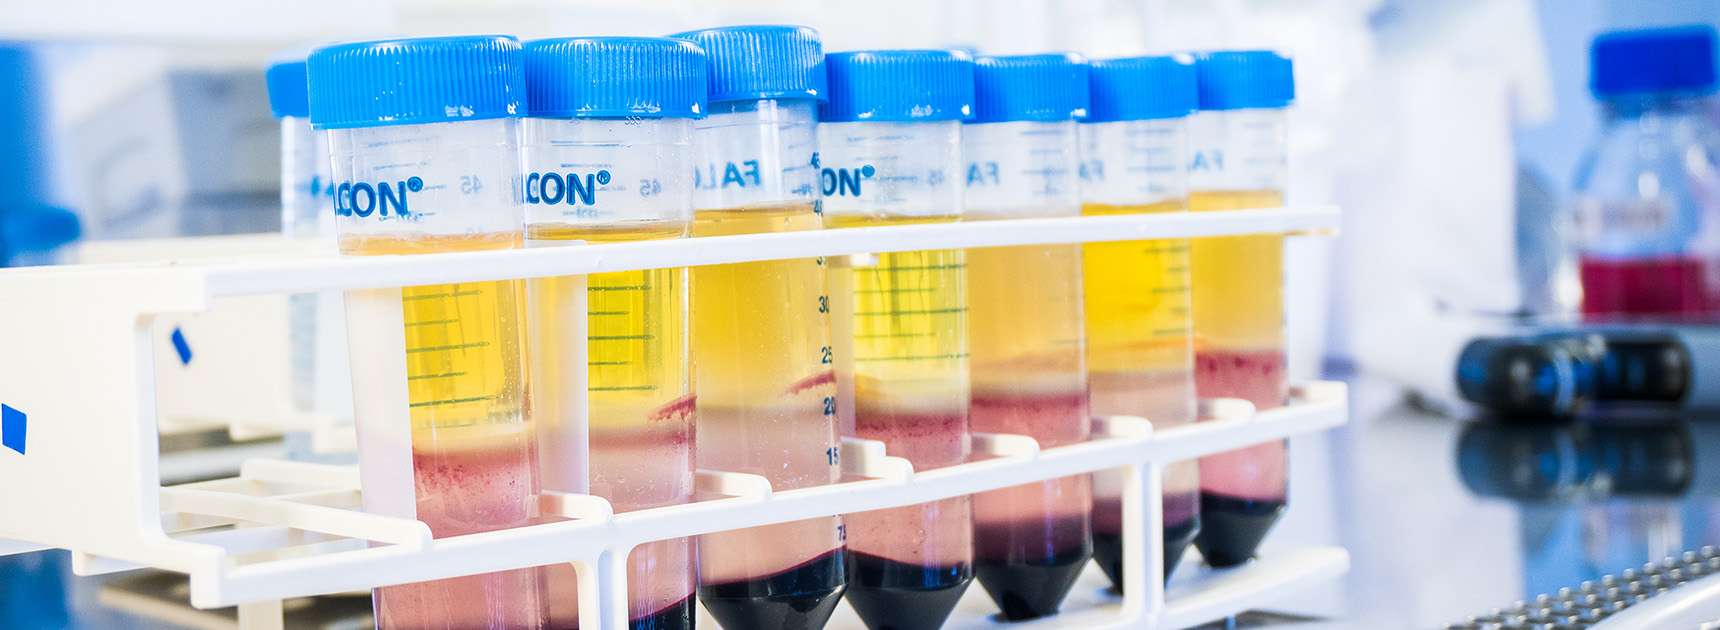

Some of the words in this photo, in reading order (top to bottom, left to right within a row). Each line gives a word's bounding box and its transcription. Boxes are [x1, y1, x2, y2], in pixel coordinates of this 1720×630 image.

[818, 295, 830, 314] 30
[821, 345, 833, 364] 25
[824, 396, 837, 416] 20
[826, 446, 839, 466] 15
